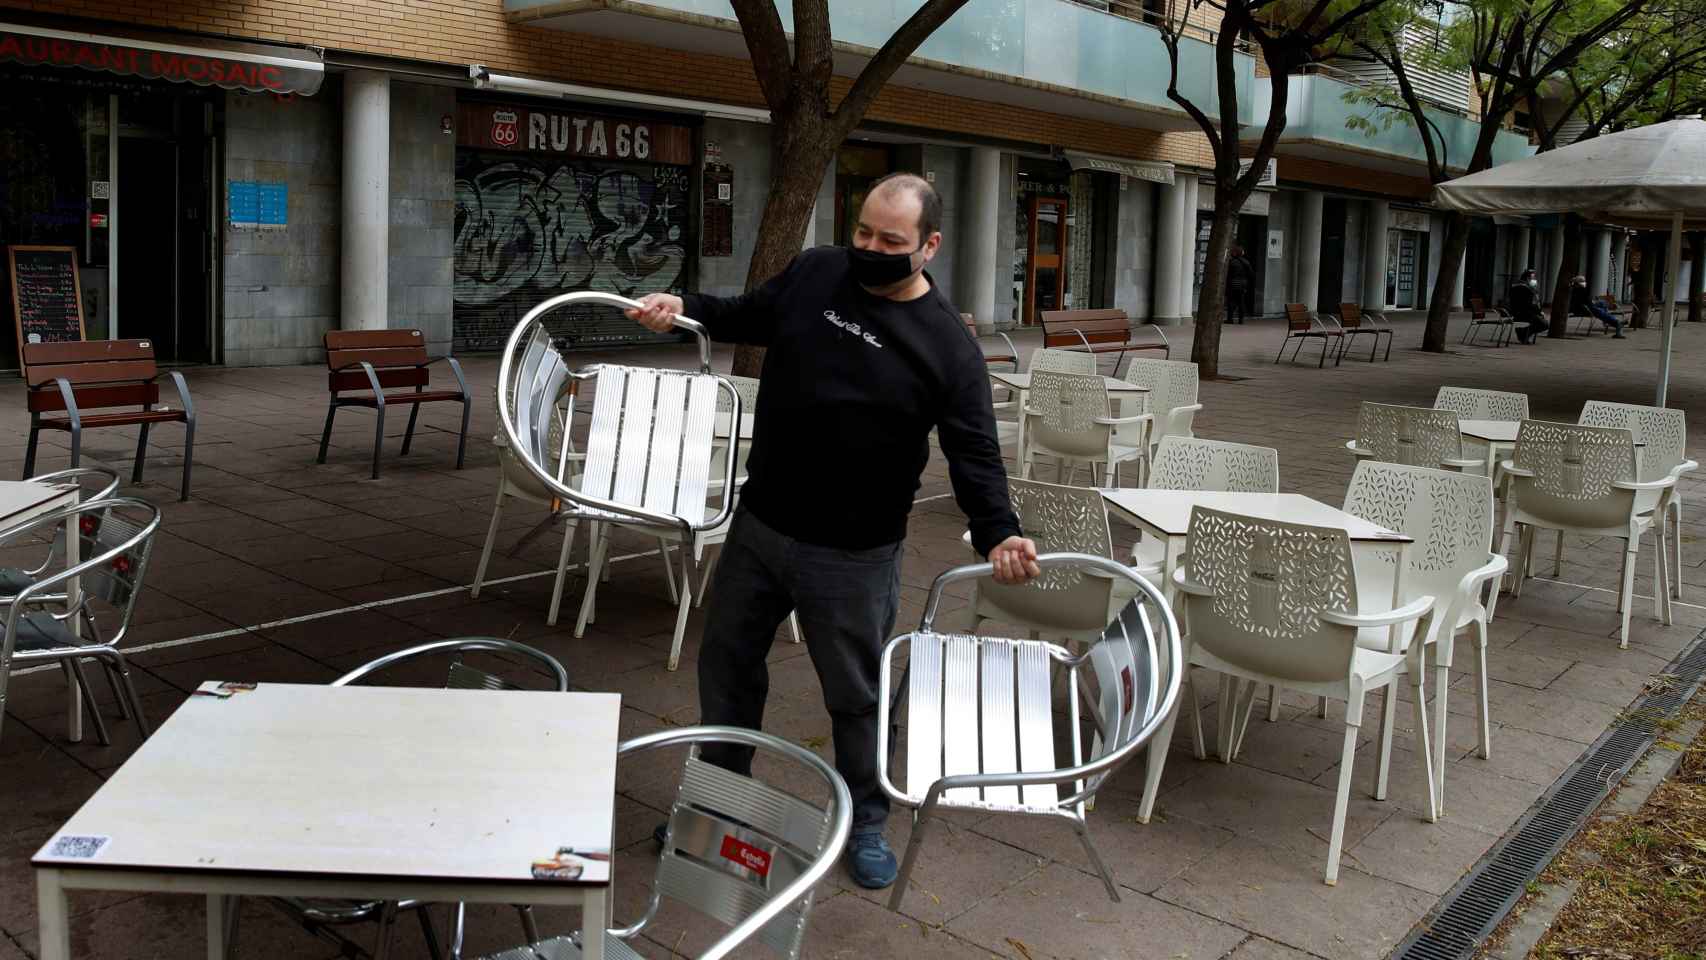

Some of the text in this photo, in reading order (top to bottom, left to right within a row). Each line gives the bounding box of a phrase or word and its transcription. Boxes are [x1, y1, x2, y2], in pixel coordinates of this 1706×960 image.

[151, 52, 285, 89] MOSAIC
[495, 123, 514, 142] 66
[528, 112, 649, 159] RUTA 66
